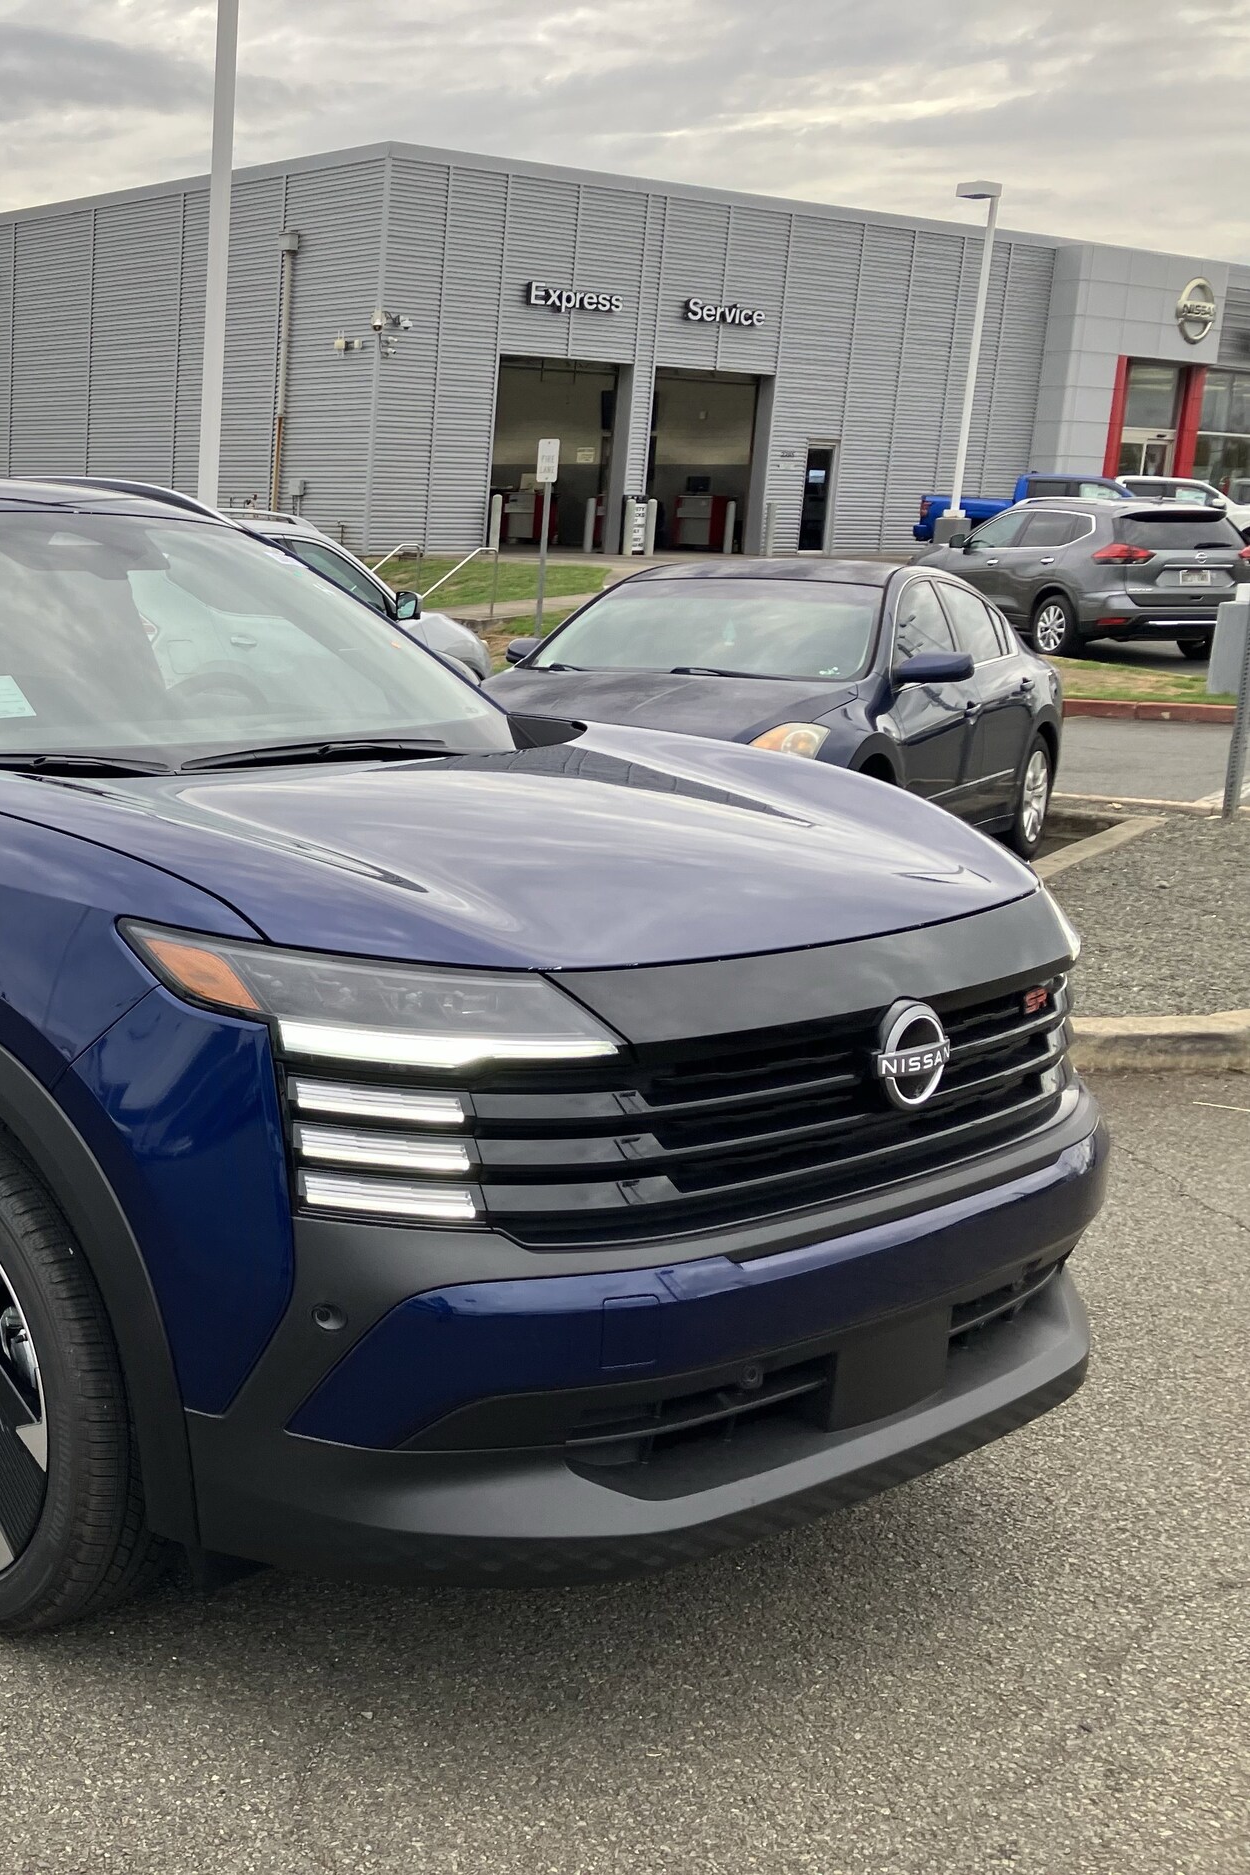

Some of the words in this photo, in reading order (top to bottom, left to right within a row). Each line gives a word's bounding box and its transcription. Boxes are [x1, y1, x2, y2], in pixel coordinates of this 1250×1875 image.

[529, 281, 624, 313] Express
[687, 298, 766, 326] Service
[539, 465, 555, 474] LANE
[541, 455, 555, 464] FIRE
[1025, 988, 1048, 1014] SR
[881, 1043, 950, 1075] NISSAN
